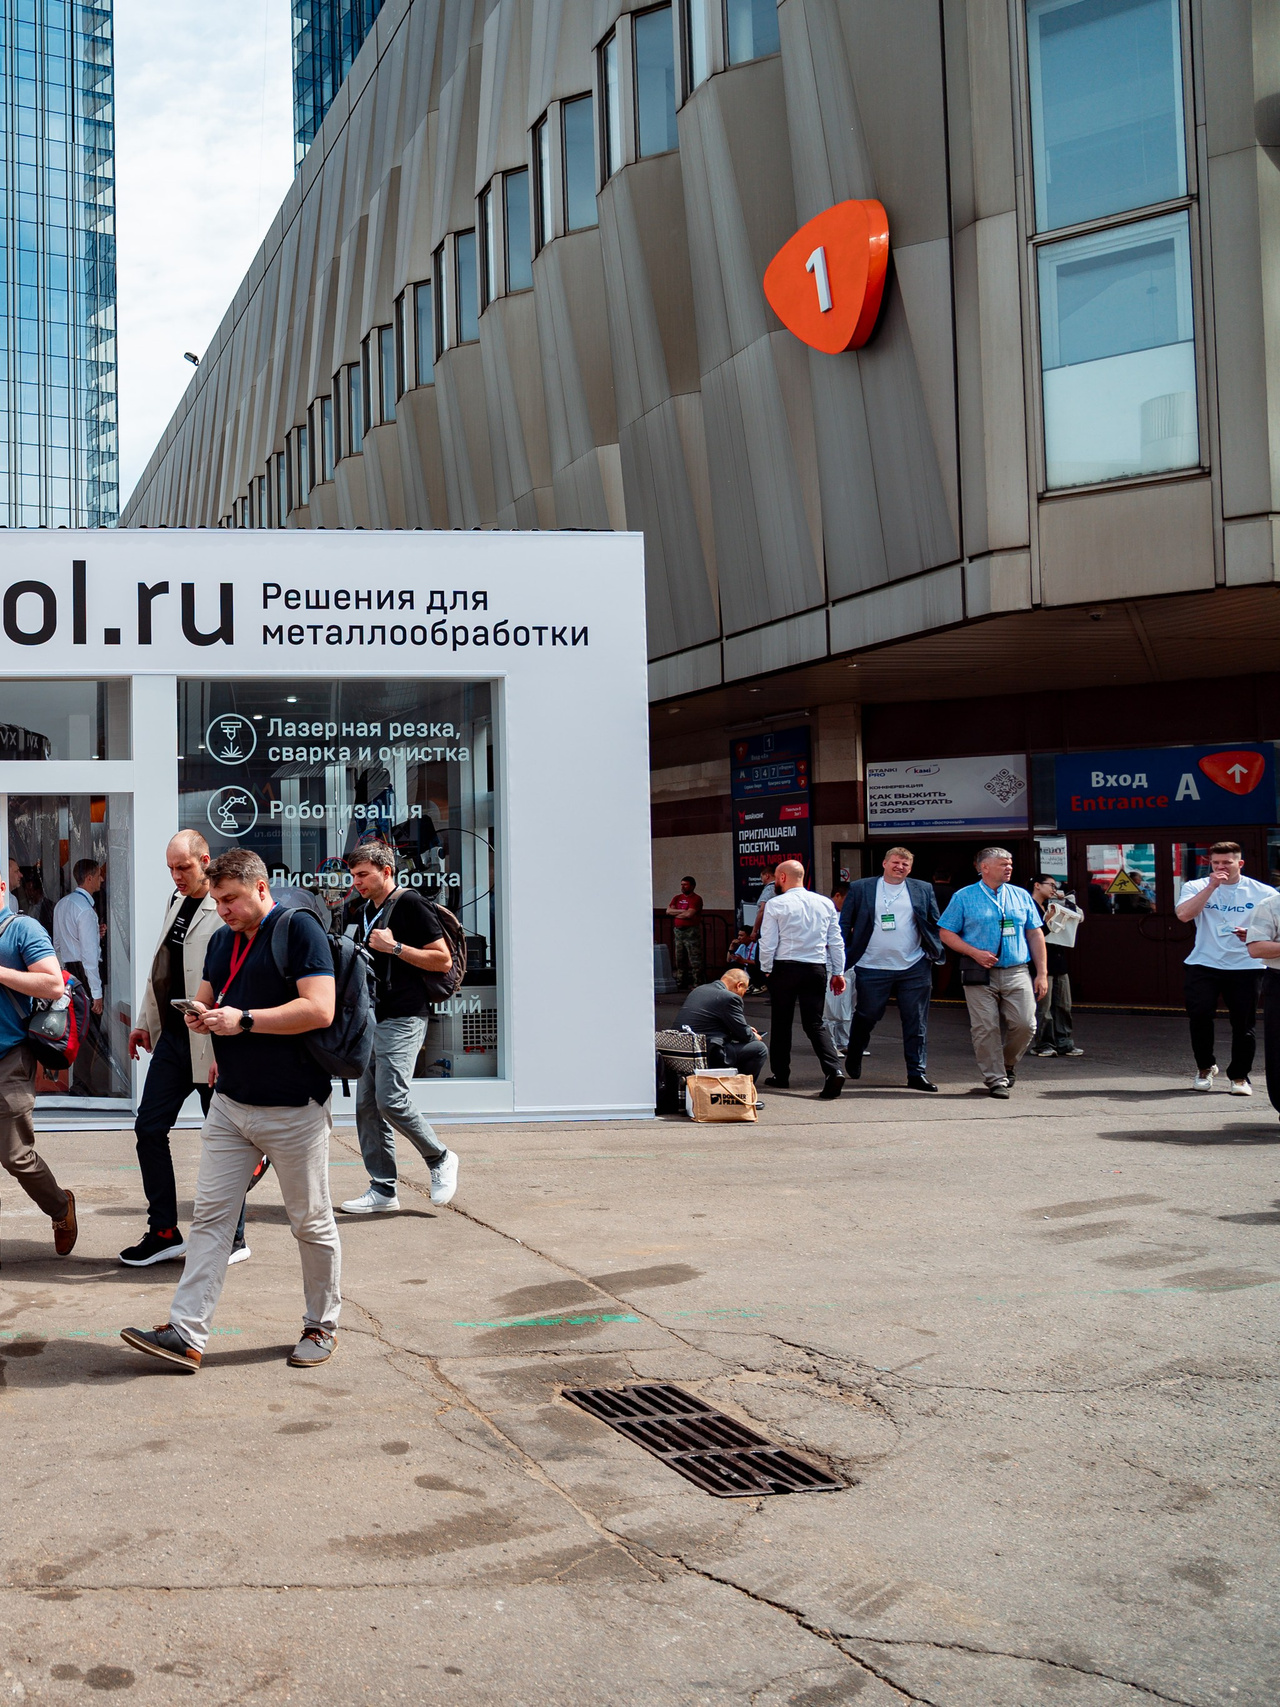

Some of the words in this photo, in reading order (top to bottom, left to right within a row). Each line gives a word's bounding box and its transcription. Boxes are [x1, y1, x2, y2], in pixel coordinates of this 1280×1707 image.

[805, 246, 833, 313] 1
[262, 582, 415, 611] Решения
[426, 589, 489, 615] для
[262, 618, 590, 652] металлообработки
[267, 717, 382, 741] Лазерная
[389, 721, 461, 742] резка,
[268, 746, 351, 765] сварка
[358, 746, 371, 762] и
[378, 746, 471, 762] очистка
[754, 770, 759, 779] 3
[762, 769, 767, 777] 4
[772, 767, 776, 776] 7
[1091, 771, 1148, 788] Вход
[894, 791, 947, 799] ВЫЖИТЬ
[1175, 773, 1201, 801] A
[270, 800, 423, 821] Роботизация
[880, 798, 953, 807] ЗАРАБОТАТЬ
[1071, 795, 1169, 812] Entrance
[738, 826, 797, 841] ПРИГЛАШАЕМ
[739, 841, 780, 854] ПОСЕТИТЬ
[740, 855, 766, 867] СТЕНД
[270, 868, 461, 888] Листооботка
